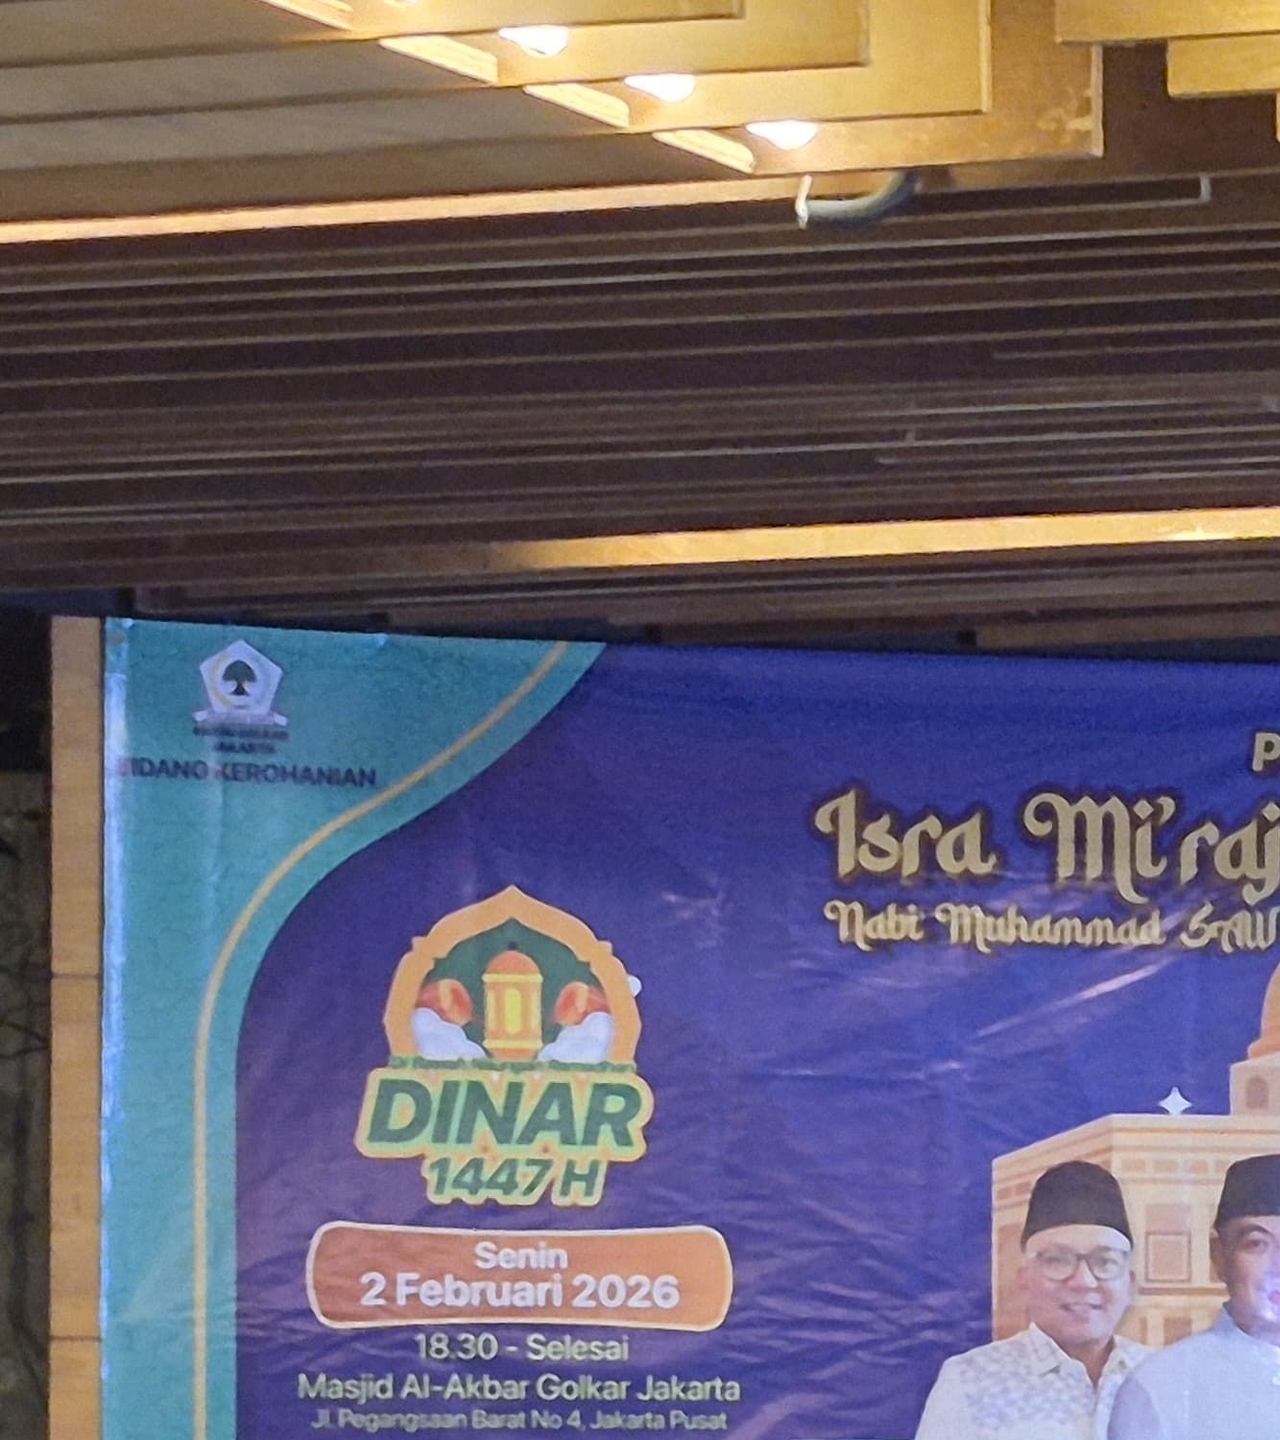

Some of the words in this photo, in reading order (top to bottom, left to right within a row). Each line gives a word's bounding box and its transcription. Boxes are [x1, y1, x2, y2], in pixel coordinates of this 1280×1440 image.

[815, 788, 997, 880] Isra
[824, 901, 924, 951] Nabi
[935, 902, 1165, 954] Muhammad
[366, 1077, 641, 1148] DINAR
[473, 1241, 568, 1270] Senin
[359, 1271, 387, 1306] 2
[395, 1272, 563, 1307] Februari
[571, 1274, 681, 1309] 2026
[413, 1331, 499, 1361] 18.30
[525, 1332, 630, 1362] Selesai
[297, 1372, 394, 1405] Masjid
[400, 1372, 530, 1400] Al-Akbar
[535, 1372, 632, 1401] Golkar
[635, 1373, 741, 1402] Jakarta
[471, 1408, 526, 1430] Barat
[530, 1408, 563, 1430] No
[589, 1409, 666, 1430] Jakarta
[669, 1408, 728, 1431] Pusat
